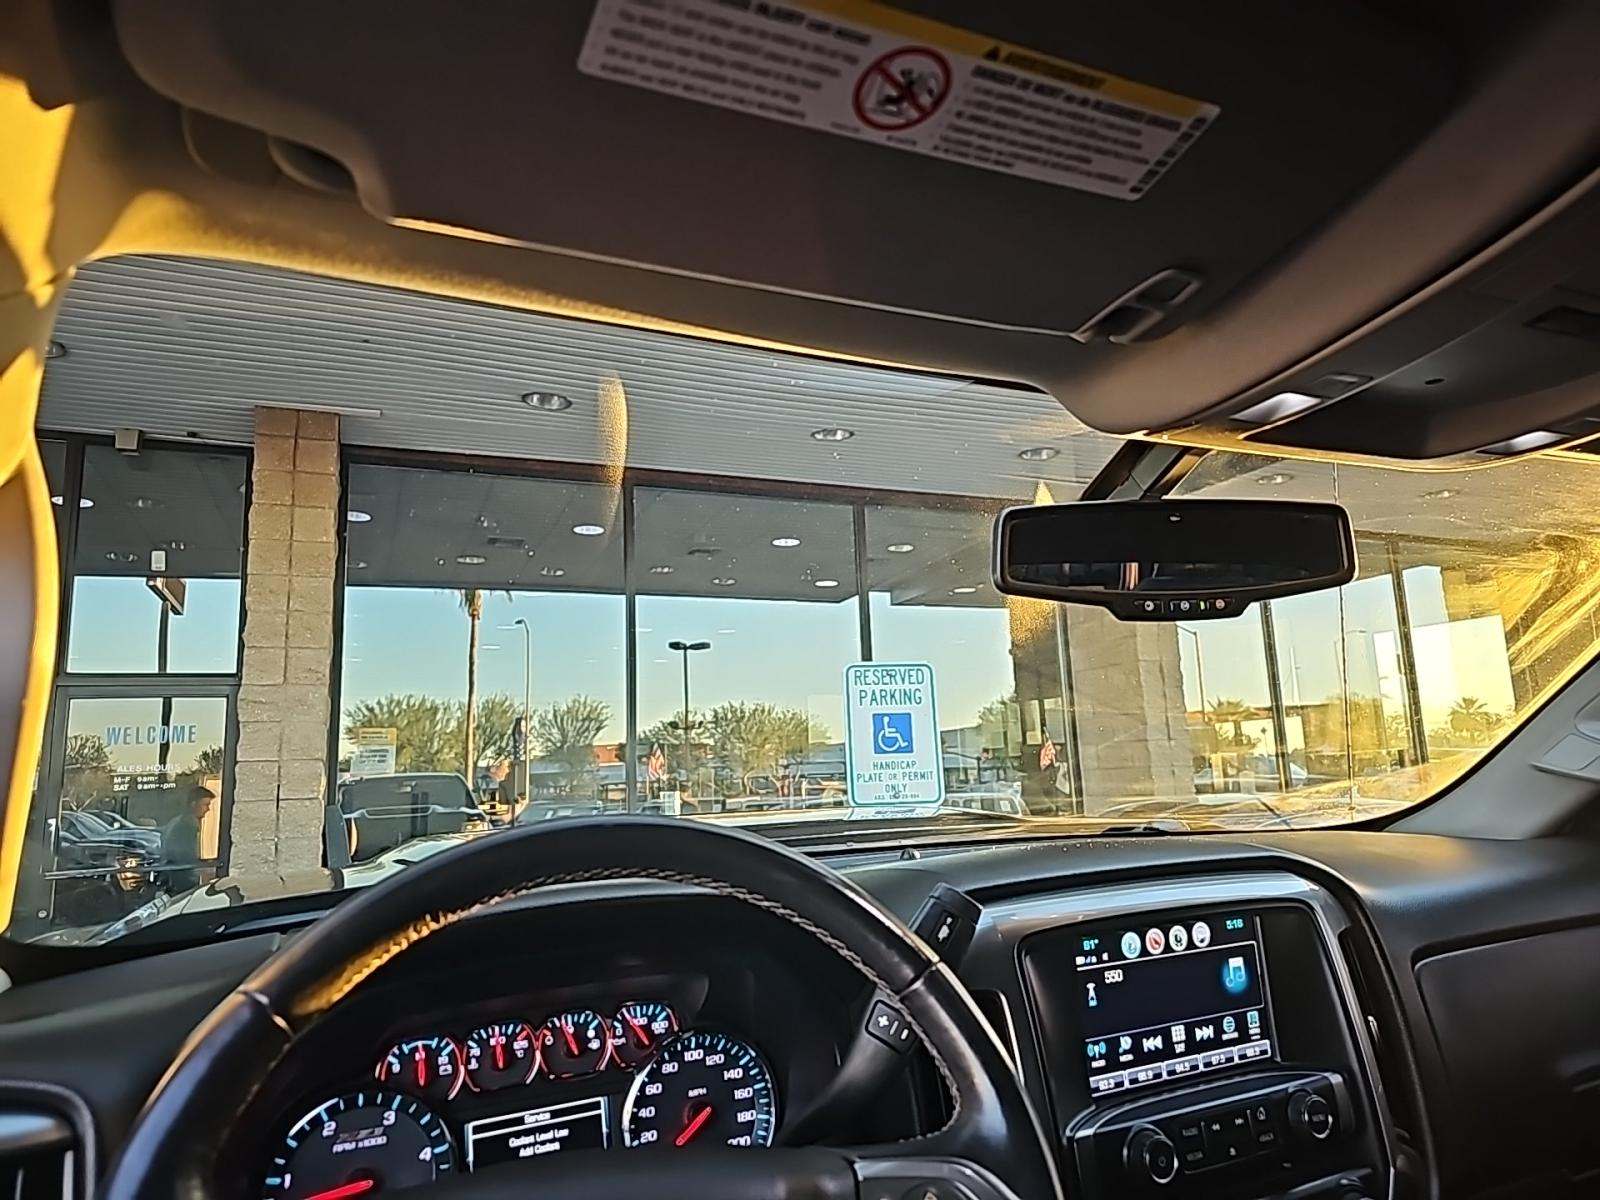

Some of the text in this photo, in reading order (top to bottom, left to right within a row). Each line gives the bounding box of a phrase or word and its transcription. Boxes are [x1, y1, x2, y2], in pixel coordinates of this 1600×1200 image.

[854, 668, 925, 686] RESERVED
[859, 688, 922, 706] PARKING
[106, 724, 197, 745] WELCOME
[872, 760, 917, 771] HANDICAP
[857, 772, 884, 783] PLATE
[902, 771, 934, 781] PERMIT
[885, 783, 908, 793] ONLY
[1104, 969, 1124, 984] 550
[684, 1049, 704, 1062] 100
[705, 1053, 725, 1066] 120
[661, 1062, 679, 1074] 80
[723, 1067, 744, 1080] 140
[645, 1083, 663, 1095] 60
[734, 1087, 754, 1099] 160
[383, 1110, 396, 1126] 3
[638, 1106, 656, 1119] 40
[737, 1110, 757, 1123] 180
[322, 1121, 337, 1138] 2
[640, 1130, 658, 1142] 20
[418, 1147, 432, 1162] 4
[283, 1173, 292, 1189] 1
